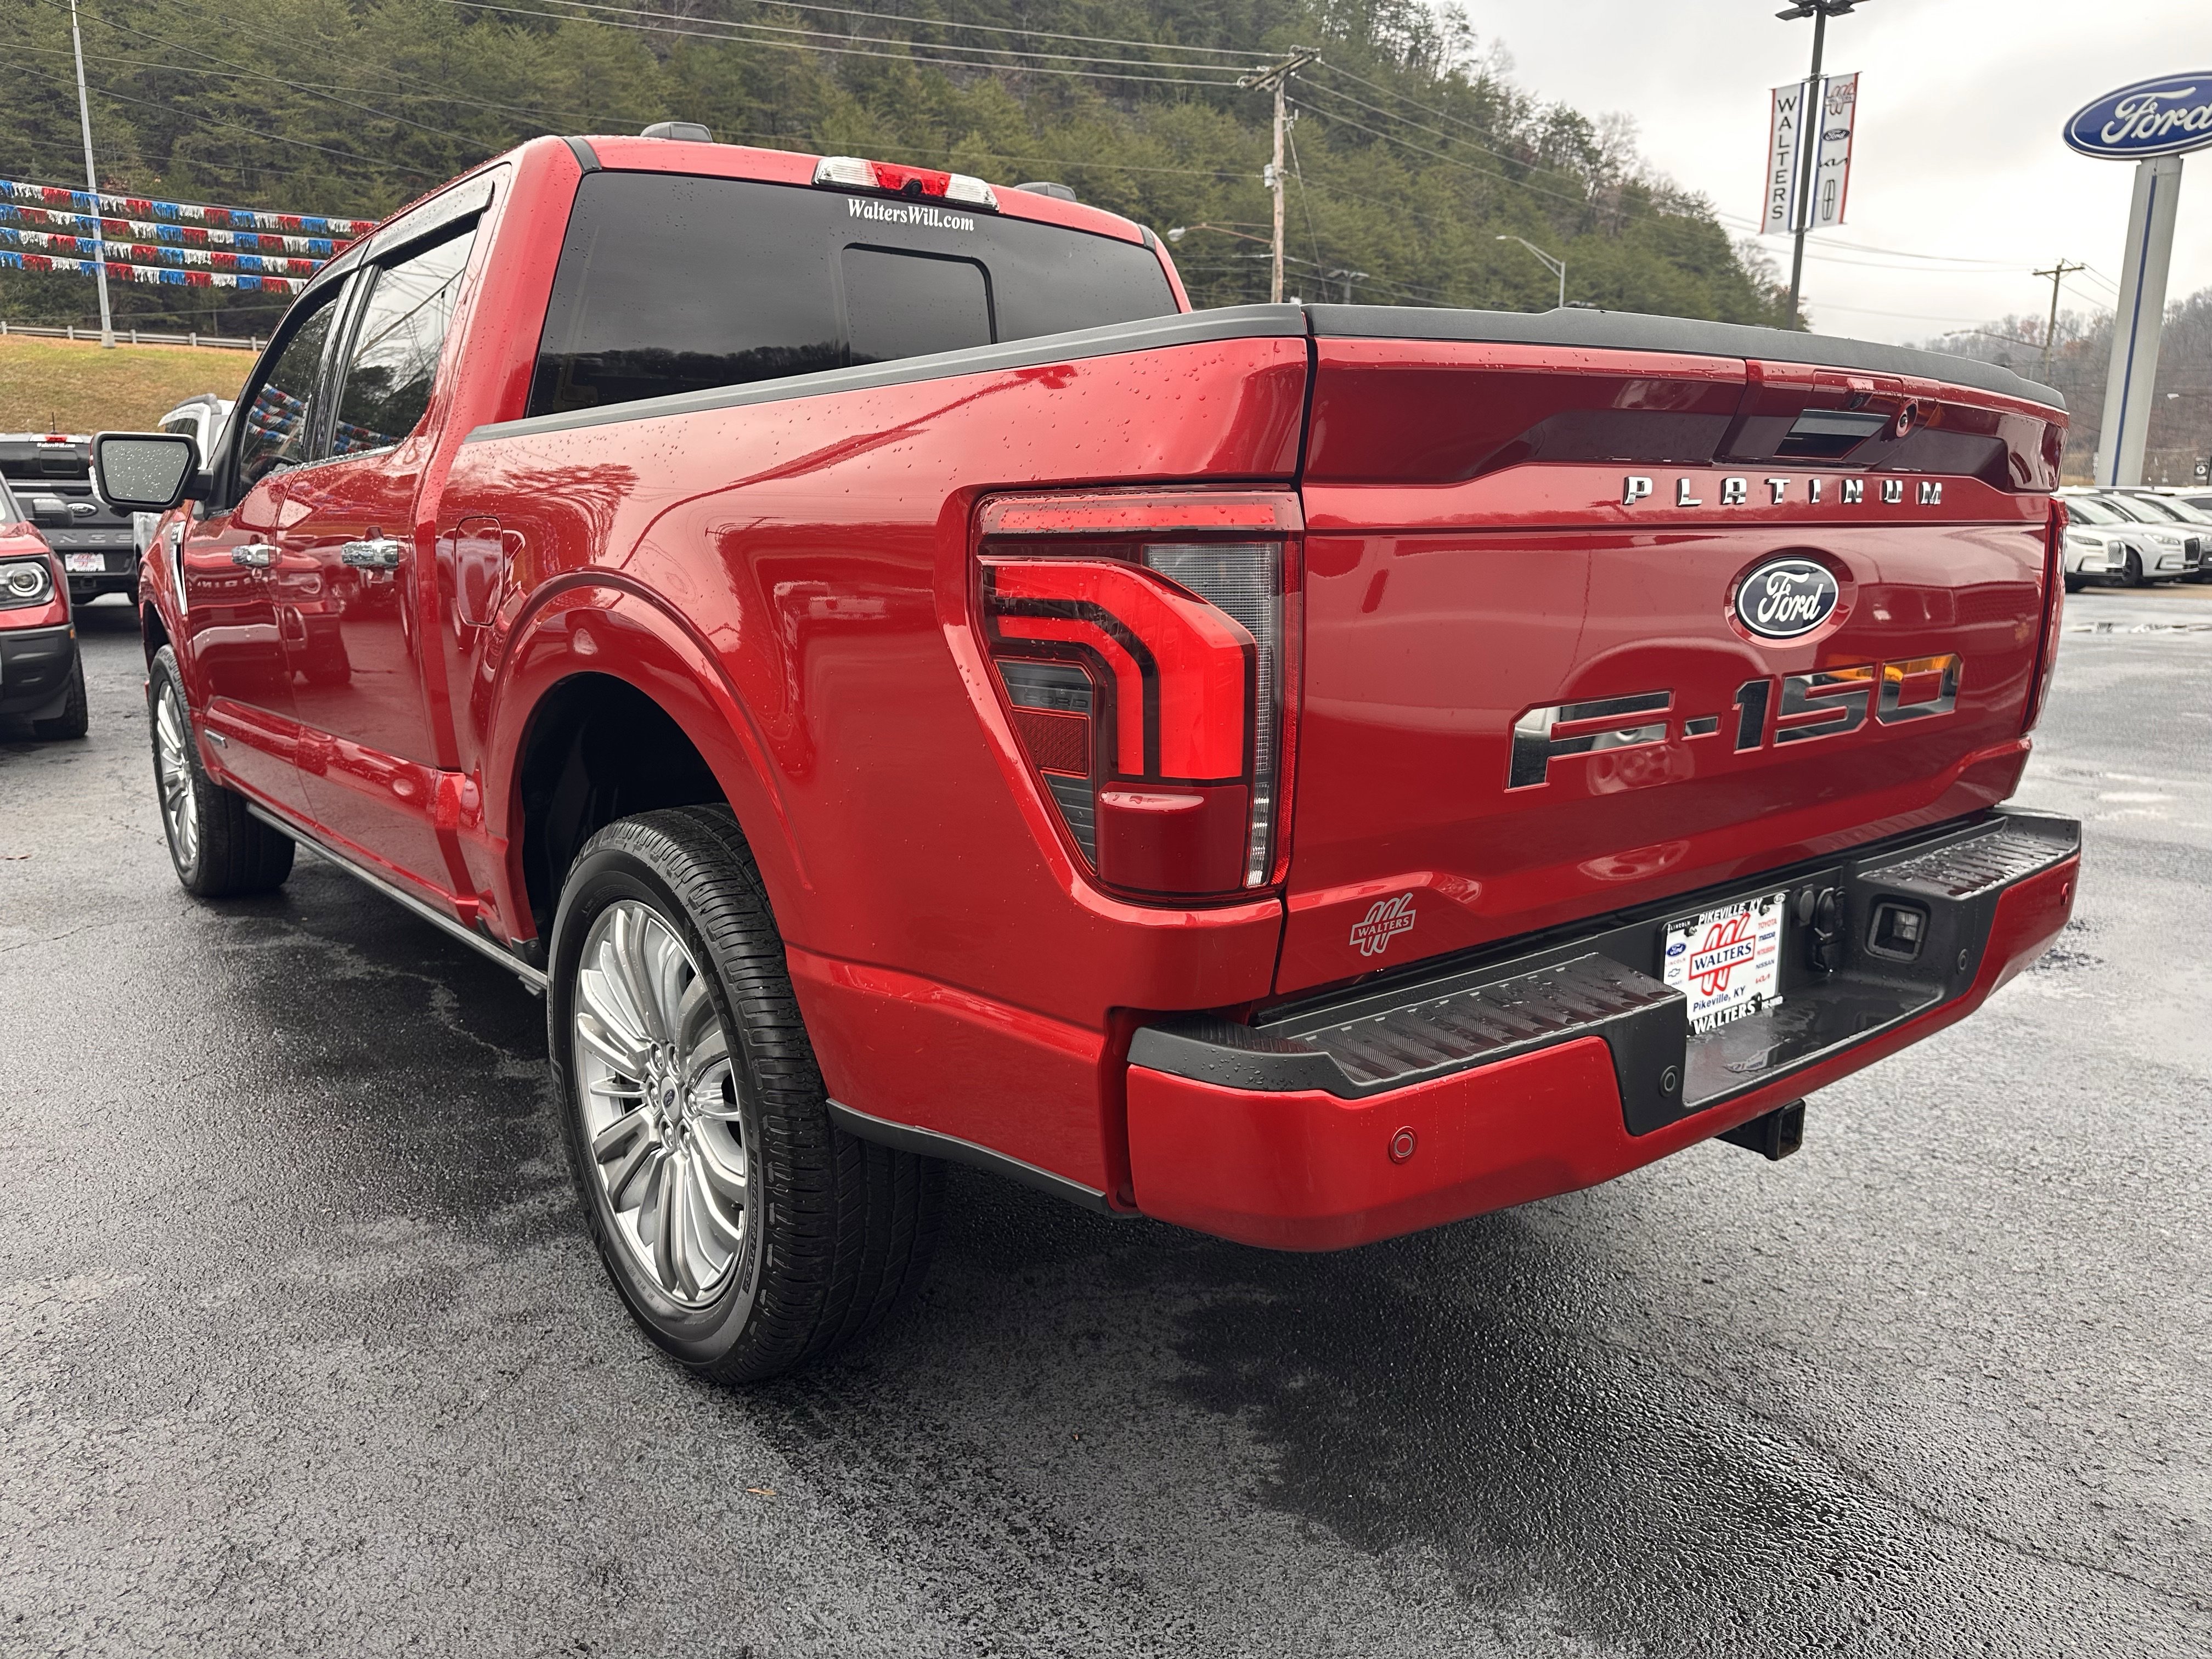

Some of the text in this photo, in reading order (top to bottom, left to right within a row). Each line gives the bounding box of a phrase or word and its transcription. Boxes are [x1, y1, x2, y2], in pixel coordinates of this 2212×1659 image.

[1771, 96, 1797, 220] WALTERS
[848, 198, 974, 231] WaltersWill.com
[1623, 476, 1942, 506] PLATINUM
[1758, 571, 1824, 622] Ford
[1505, 653, 1963, 792] F-150
[1749, 898, 1763, 912] KY
[1358, 917, 1409, 937] WALTERS
[1758, 918, 1777, 929] TOYOTA
[1666, 958, 1686, 967] LINCOLN
[1695, 942, 1752, 970] WALTERS
[1756, 959, 1775, 969] NISSAN
[1693, 985, 1746, 1012] Pikeville, KY
[1693, 1000, 1756, 1035] WALTERS
